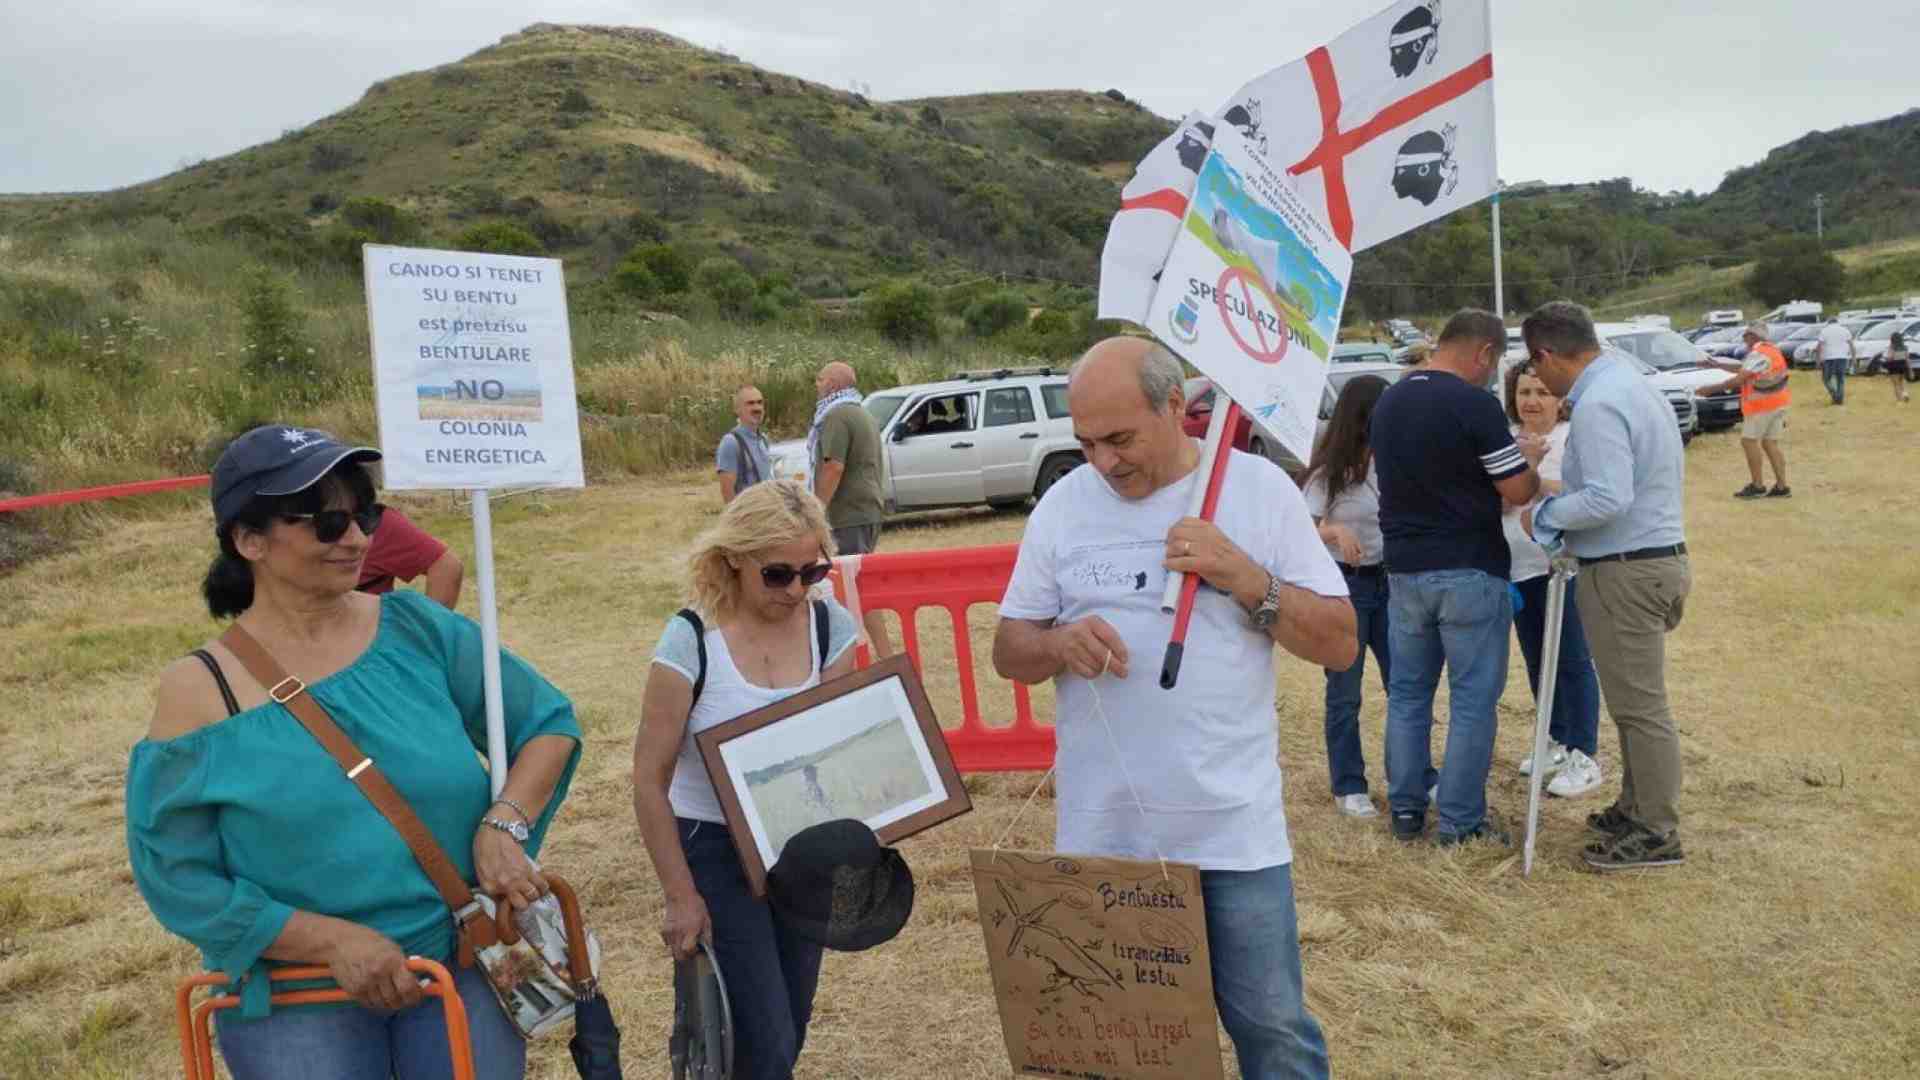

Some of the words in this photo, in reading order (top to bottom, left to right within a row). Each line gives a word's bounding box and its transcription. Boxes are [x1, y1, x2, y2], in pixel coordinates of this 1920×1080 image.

[389, 262, 459, 279] CANDO
[466, 266, 481, 278] SI
[488, 267, 543, 283] TENET
[423, 288, 448, 302] SU
[455, 290, 517, 306] BENTU
[1189, 277, 1312, 351] SPECULAZIONI
[419, 316, 449, 331] est
[453, 318, 527, 335] pretzisu
[420, 345, 531, 362] BENTULARE
[454, 378, 505, 400] NO
[439, 420, 527, 437] COLONIA
[425, 448, 547, 465] ENERGETICA
